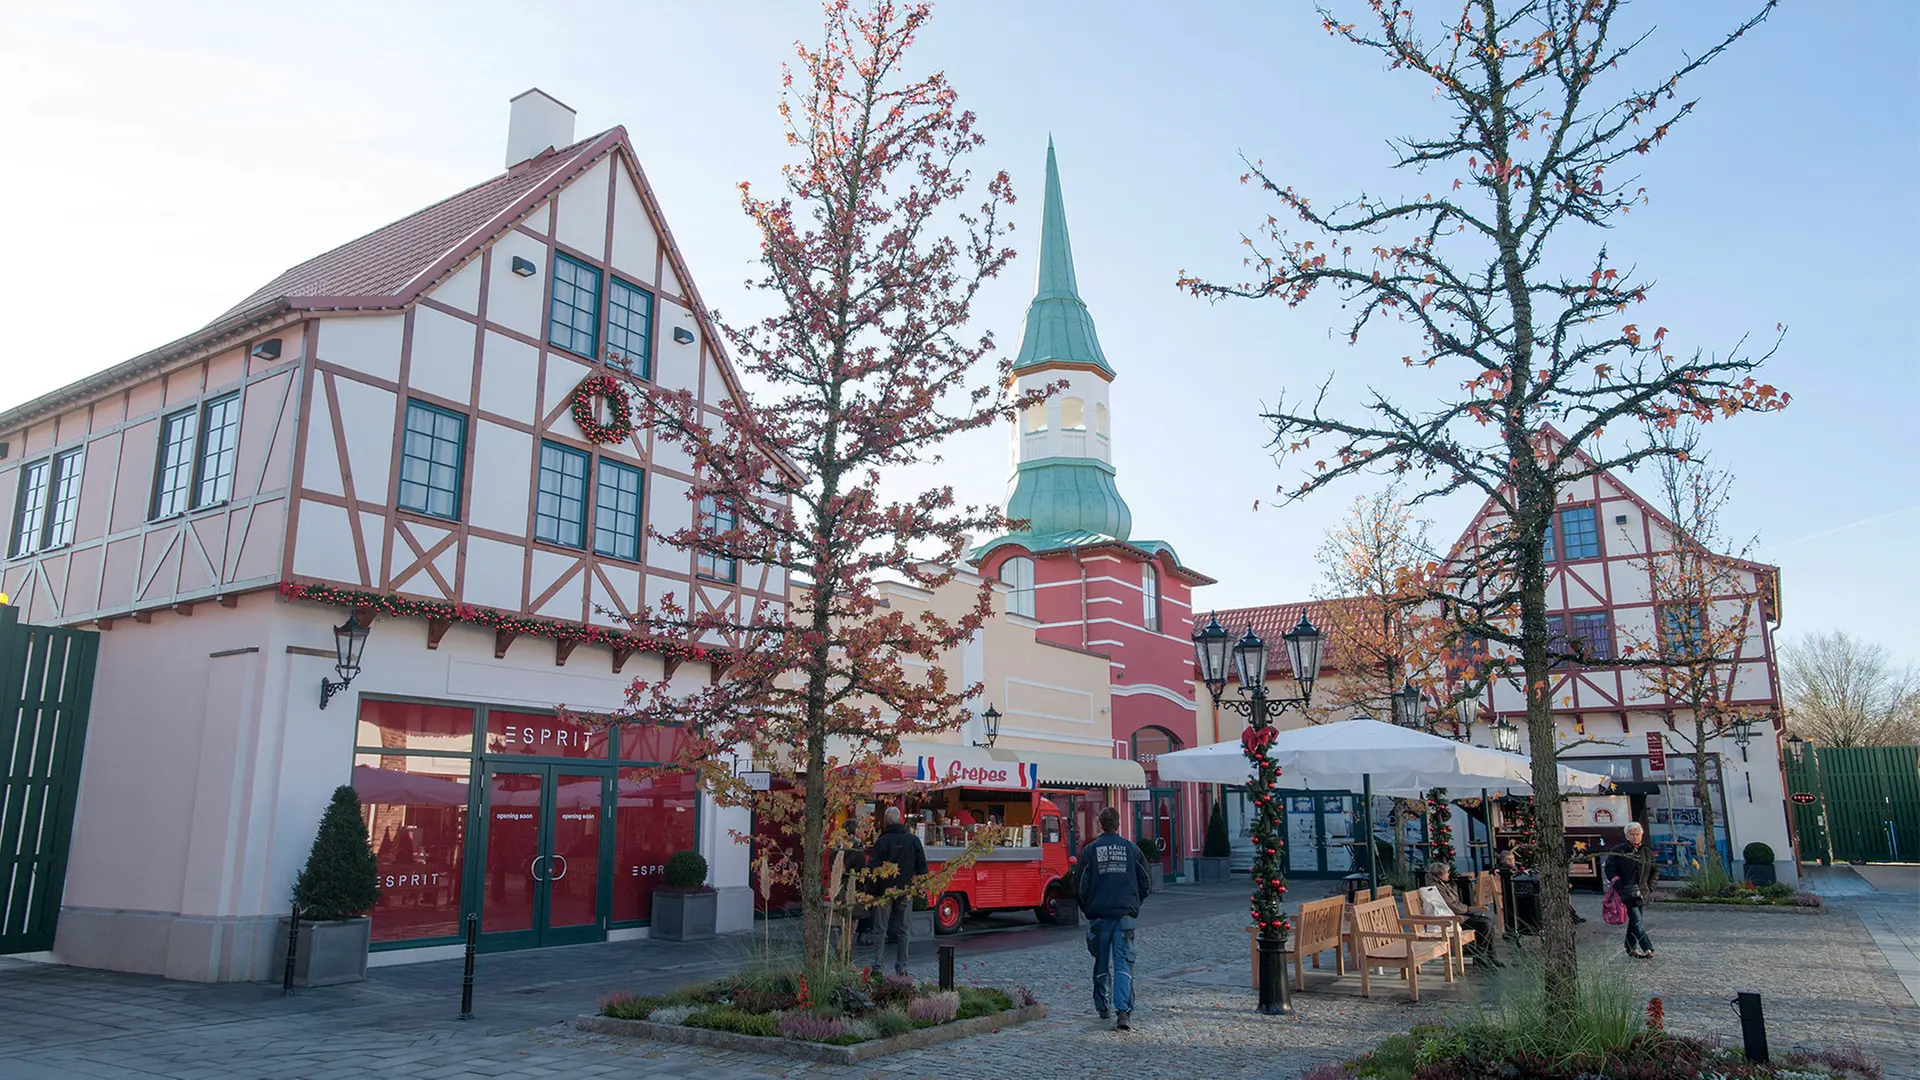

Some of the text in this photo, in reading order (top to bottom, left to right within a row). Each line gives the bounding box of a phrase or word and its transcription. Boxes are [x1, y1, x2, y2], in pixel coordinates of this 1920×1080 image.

[505, 726, 593, 748] ESPRIT
[496, 812, 519, 820] opening
[561, 812, 581, 821] opening
[632, 864, 665, 876] ESPR
